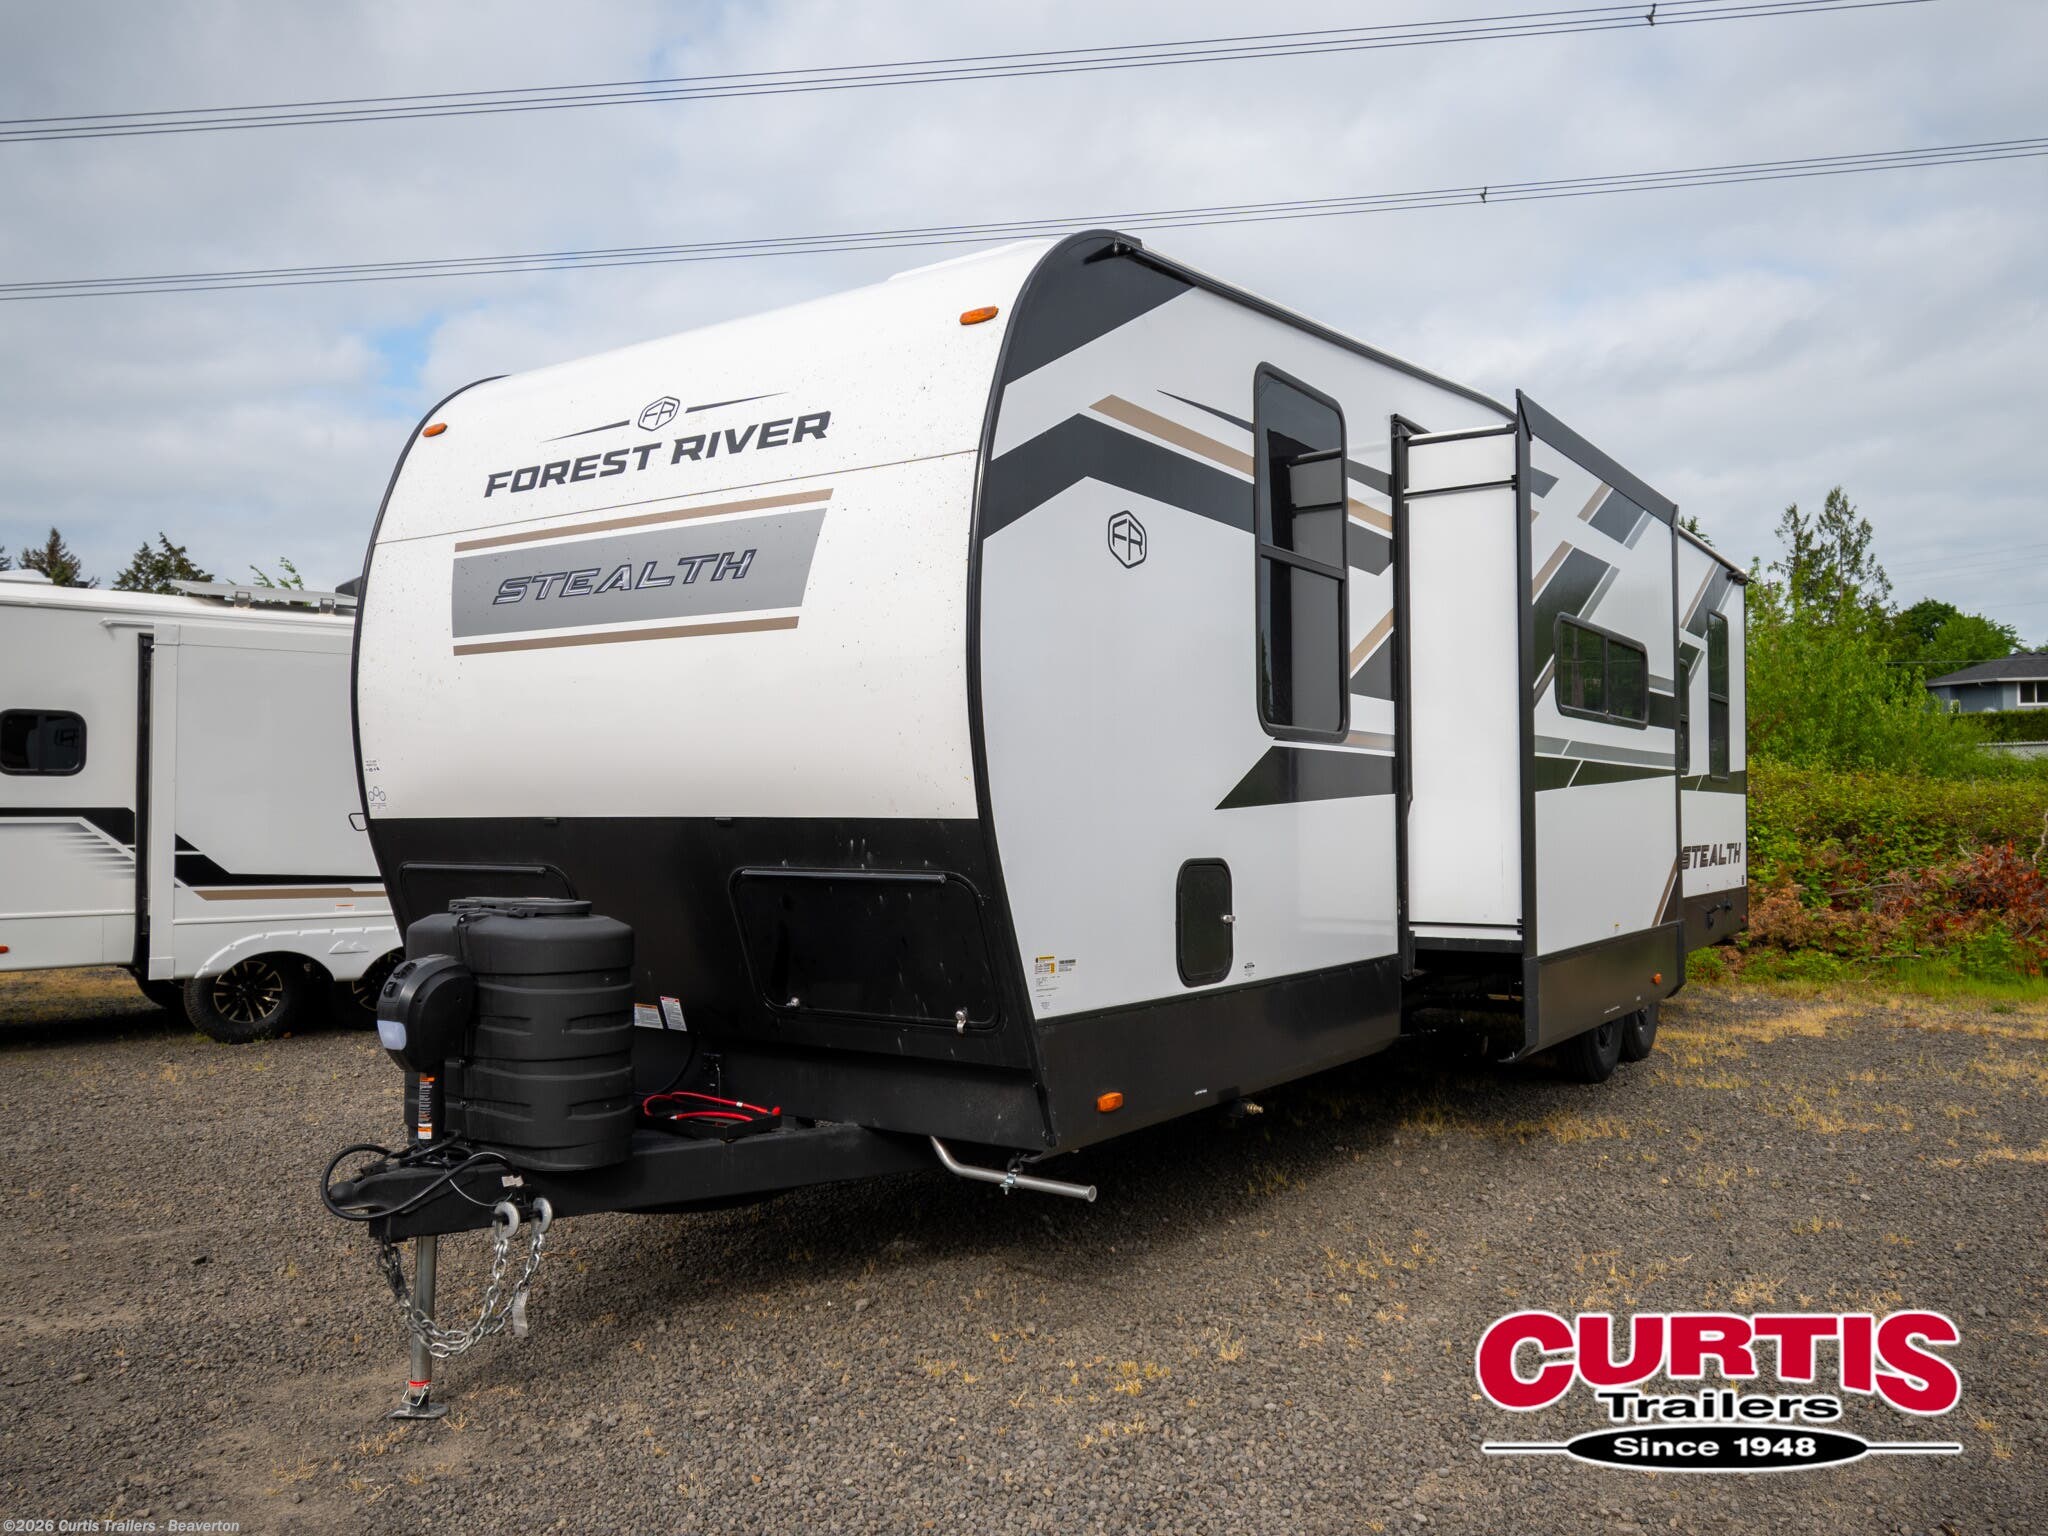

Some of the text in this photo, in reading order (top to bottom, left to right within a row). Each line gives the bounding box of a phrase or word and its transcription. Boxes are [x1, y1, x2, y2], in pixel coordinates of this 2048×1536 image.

[484, 411, 832, 498] FOREST RIVER
[492, 549, 757, 605] STEALTH
[1681, 842, 1742, 870] STEALTH
